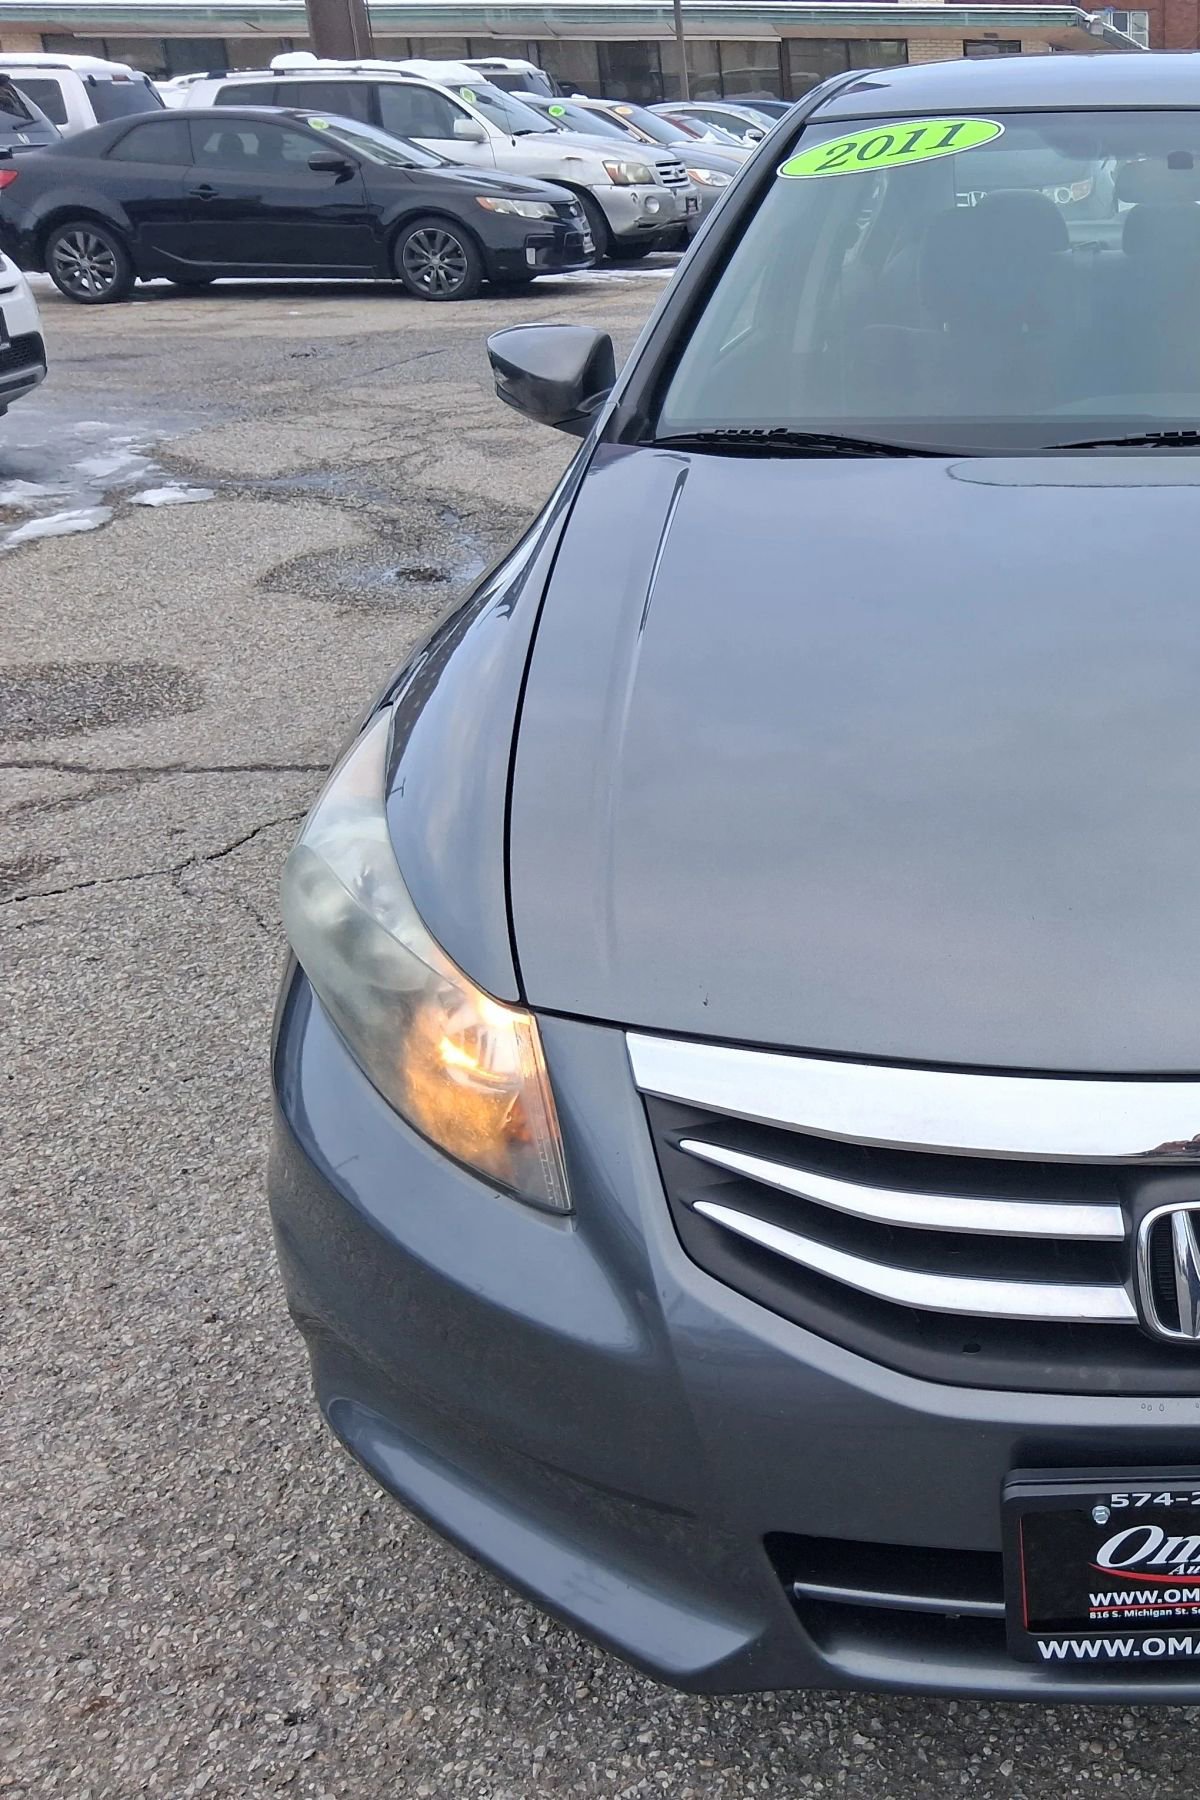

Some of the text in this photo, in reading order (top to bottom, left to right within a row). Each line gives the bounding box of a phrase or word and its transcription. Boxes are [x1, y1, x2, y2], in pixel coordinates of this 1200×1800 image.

[814, 122, 966, 172] 2011
[1111, 1610, 1122, 1618] S.
[1124, 1608, 1173, 1618] Michigan
[1175, 1607, 1189, 1615] St.
